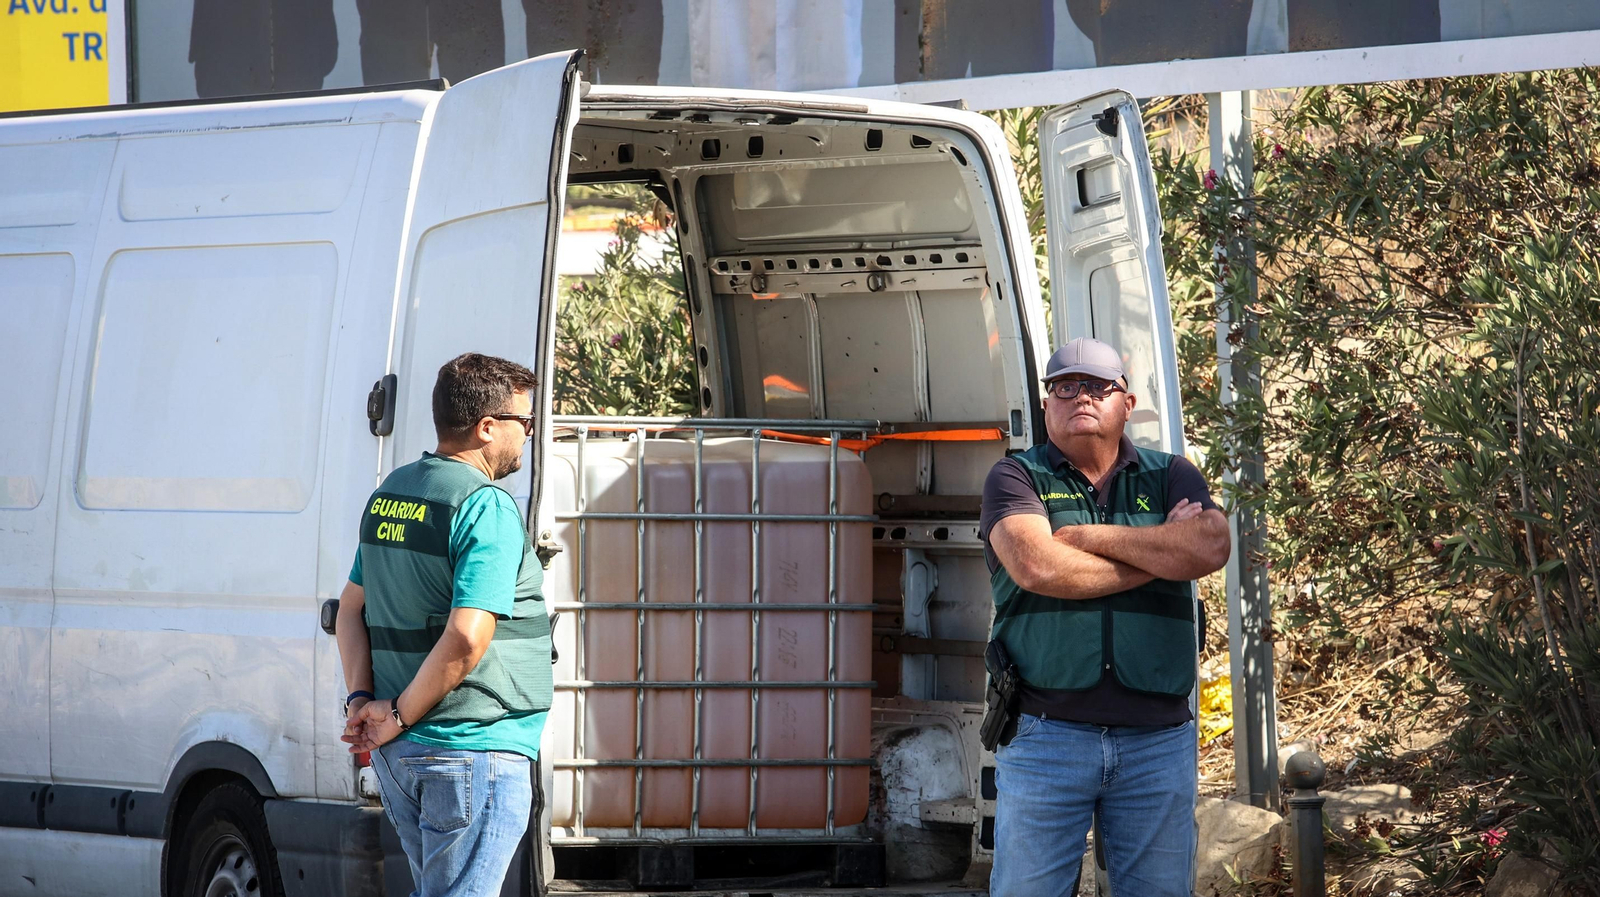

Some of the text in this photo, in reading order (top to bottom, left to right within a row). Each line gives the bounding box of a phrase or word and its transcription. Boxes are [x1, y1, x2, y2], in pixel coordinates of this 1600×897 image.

[62, 32, 107, 62] TR
[370, 497, 427, 522] GUARDIA
[377, 521, 405, 542] CIVIL
